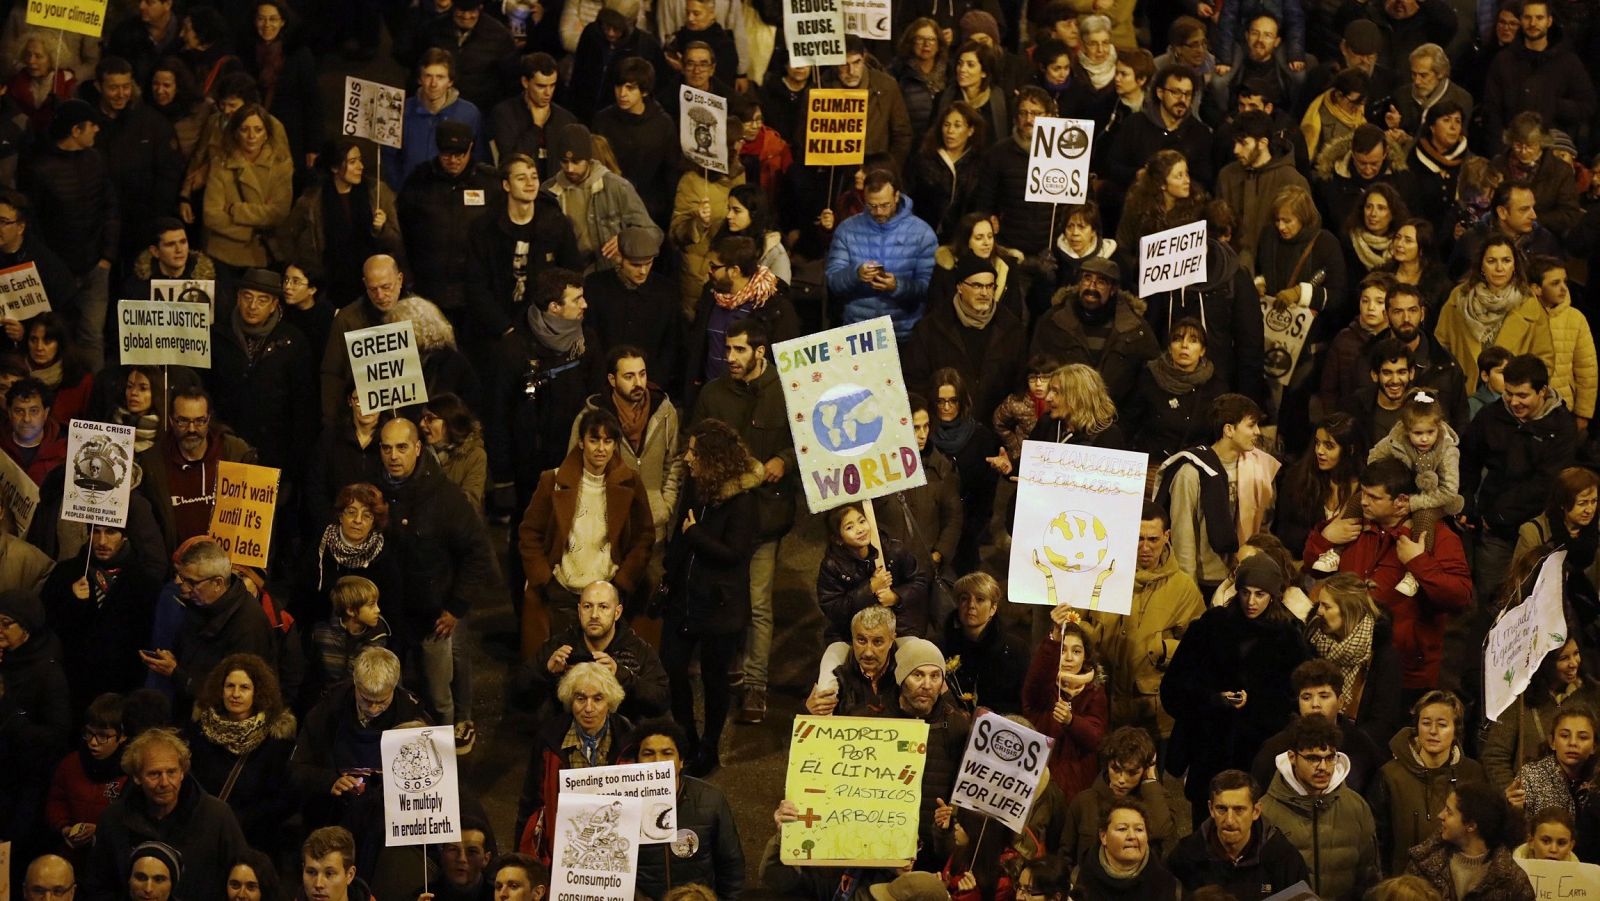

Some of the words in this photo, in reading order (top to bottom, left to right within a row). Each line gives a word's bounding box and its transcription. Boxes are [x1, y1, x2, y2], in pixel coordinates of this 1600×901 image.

[31, 1, 42, 14] no
[43, 4, 67, 19] your
[68, 6, 101, 27] climate.
[797, 19, 835, 35] REUSE,
[793, 40, 843, 57] RECYCLE.
[344, 81, 361, 136] CRISIS
[812, 98, 865, 113] CLIMATE
[810, 118, 863, 133] CHANGE
[808, 139, 862, 154] KILLS!
[1046, 176, 1066, 184] ECO
[1146, 240, 1167, 259] WE
[1169, 229, 1204, 255] FIGTH
[1143, 263, 1171, 285] FOR
[1173, 254, 1202, 278] LIFE!
[10, 274, 40, 291] Earth,
[7, 301, 20, 310] we
[20, 292, 35, 307] kill
[122, 309, 164, 326] CLIMATE
[166, 310, 208, 332] JUSTICE,
[123, 332, 153, 352] global
[155, 336, 208, 356] emergency.
[351, 330, 409, 358] GREEN
[778, 341, 831, 373] SAVE
[846, 327, 888, 356] THE
[366, 358, 404, 383] NEW
[368, 383, 416, 410] DEAL!
[72, 421, 104, 432] GLOBAL
[105, 425, 132, 435] CRISIS
[811, 446, 918, 500] WORLD
[220, 477, 247, 500] Don't
[250, 485, 274, 504] wait
[64, 511, 85, 519] PEOPLES
[104, 516, 122, 524] PLANET
[218, 508, 242, 526] until
[244, 509, 262, 530] it's
[234, 535, 264, 558] late.
[816, 727, 899, 742] MADRID
[995, 735, 1022, 752] ECO
[838, 744, 877, 760] POR
[896, 740, 926, 755] ECO
[994, 743, 1018, 757] CRISIS
[565, 777, 603, 790] Spending
[605, 776, 619, 784] too
[621, 770, 645, 783] much
[647, 772, 654, 780] is
[655, 769, 671, 780] bad
[800, 760, 823, 774] EL
[831, 762, 896, 781] CLIMA
[964, 760, 990, 780] WE
[989, 771, 1032, 799] FIGTH
[399, 794, 411, 811] We
[412, 792, 443, 813] multiply
[640, 786, 671, 798] climate.
[956, 780, 989, 802] FOR
[989, 793, 1026, 819] LIFE!
[392, 822, 399, 837] in
[401, 818, 427, 837] eroded
[428, 816, 454, 834] Earth.
[826, 809, 907, 825] ARBOLES
